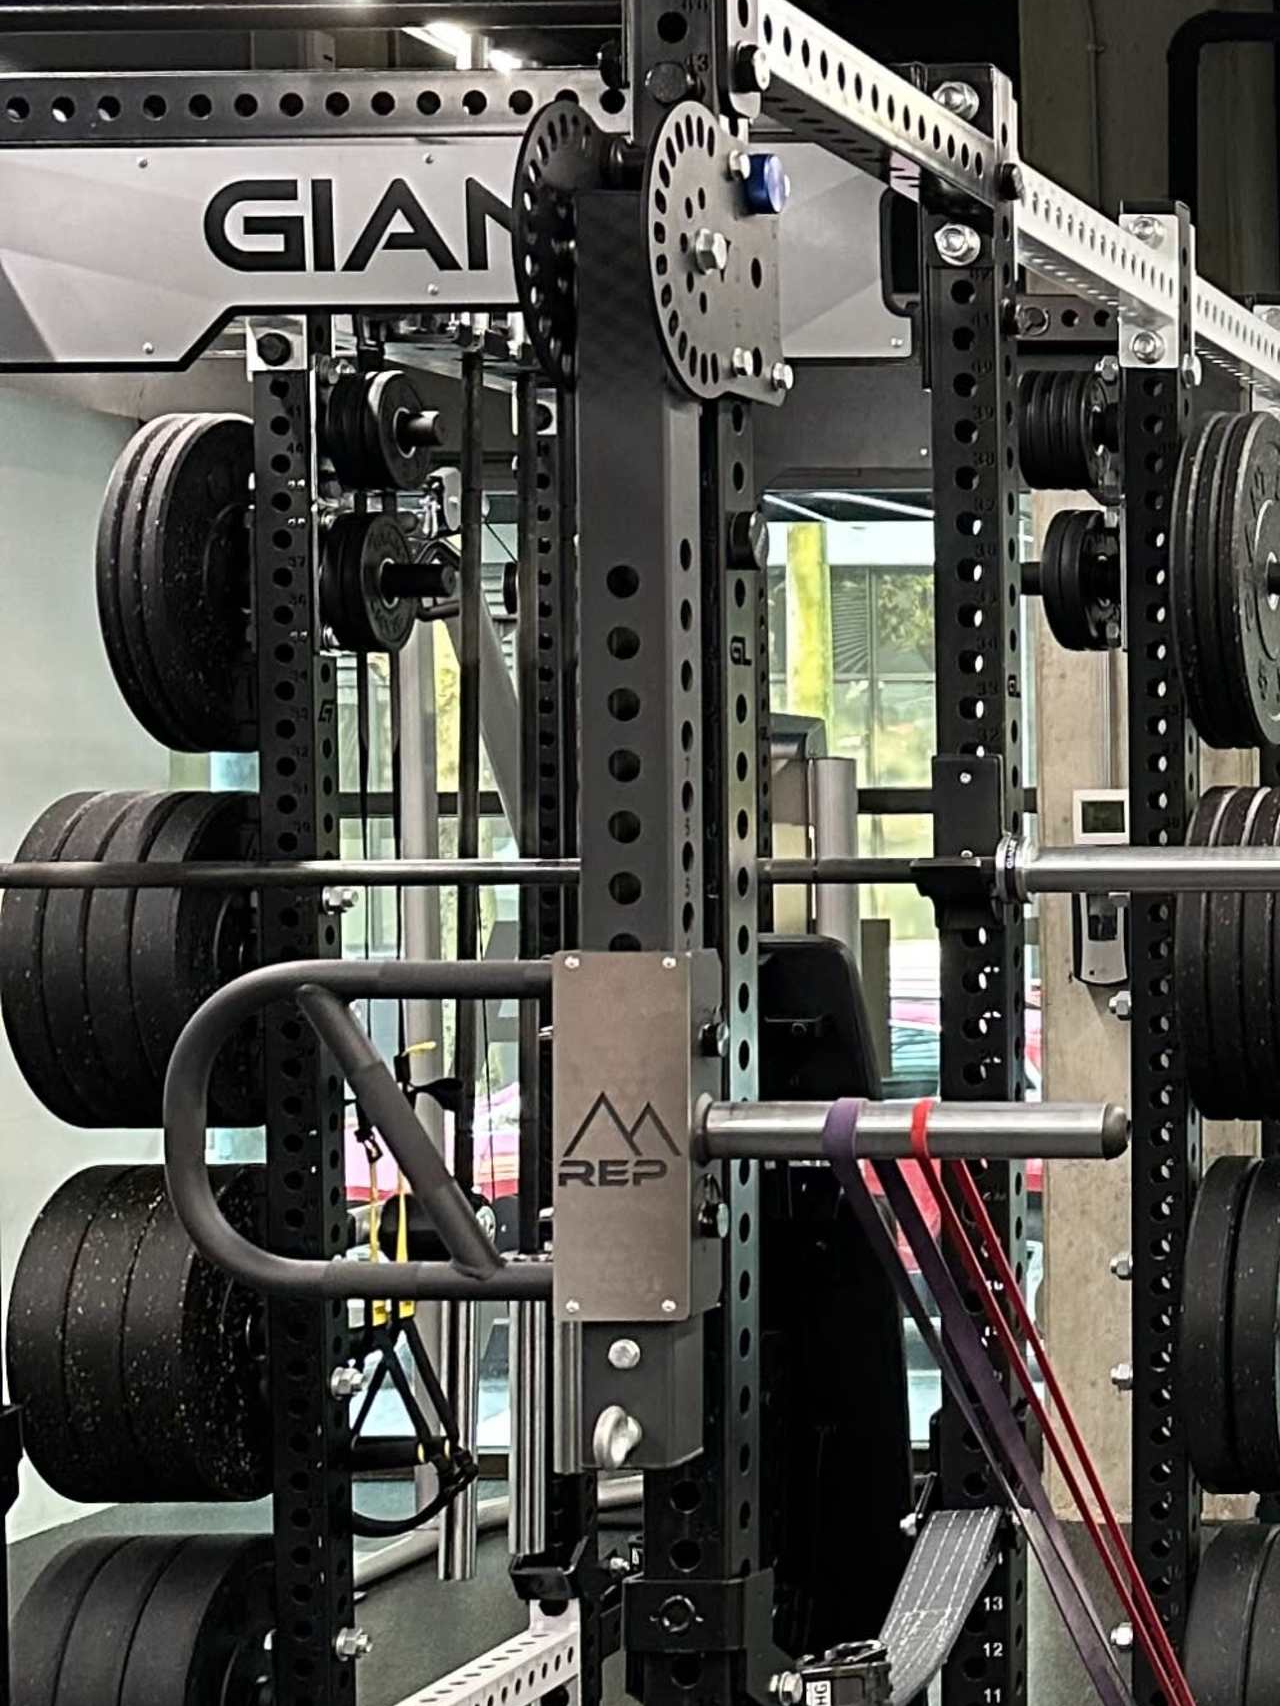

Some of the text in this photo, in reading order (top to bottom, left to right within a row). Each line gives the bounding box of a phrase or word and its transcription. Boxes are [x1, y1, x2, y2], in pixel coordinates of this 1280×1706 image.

[203, 178, 513, 272] GIAN
[558, 1159, 668, 1187] REP
[984, 1596, 1003, 1611] 13
[983, 1642, 1003, 1657] 12
[984, 1688, 1001, 1704] 11
